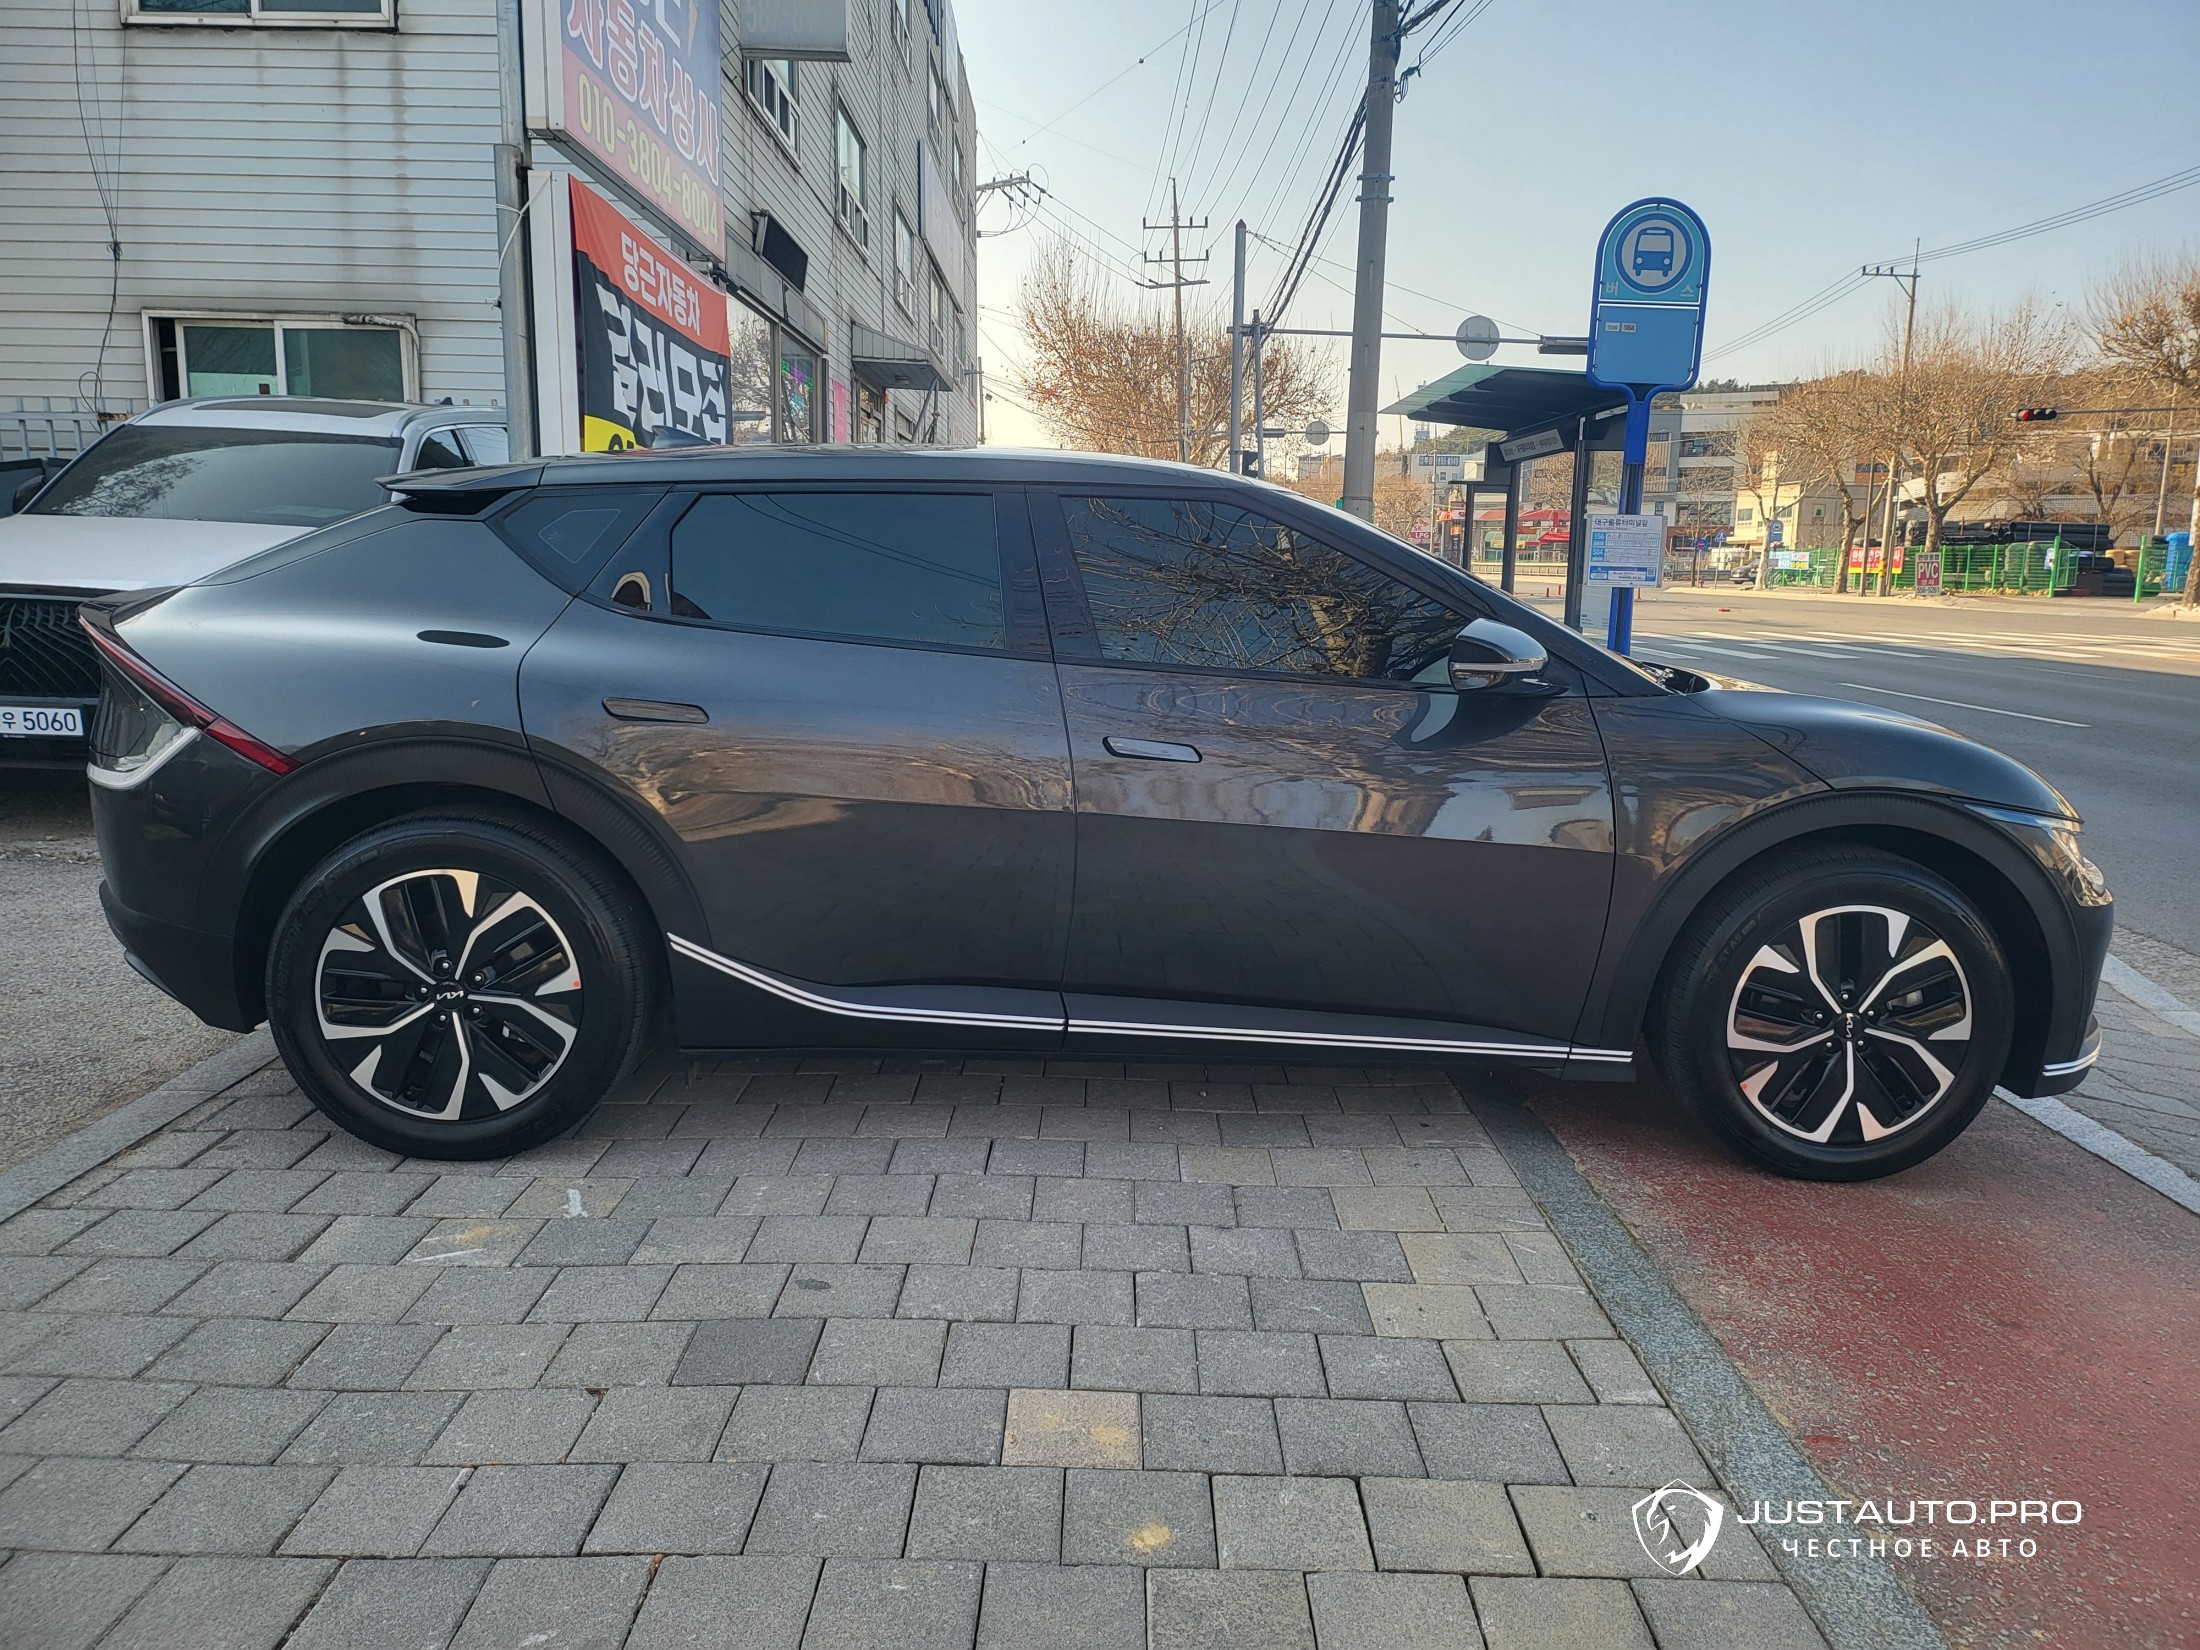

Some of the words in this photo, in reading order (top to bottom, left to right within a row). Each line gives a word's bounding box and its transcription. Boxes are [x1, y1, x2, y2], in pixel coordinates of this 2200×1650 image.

[577, 73, 720, 244] 010-3804-8004
[620, 231, 701, 337] 당근자동차
[1606, 280, 1619, 297] 버
[1680, 284, 1695, 298] 스
[1918, 562, 1939, 579] PVC
[22, 711, 77, 732] 5060
